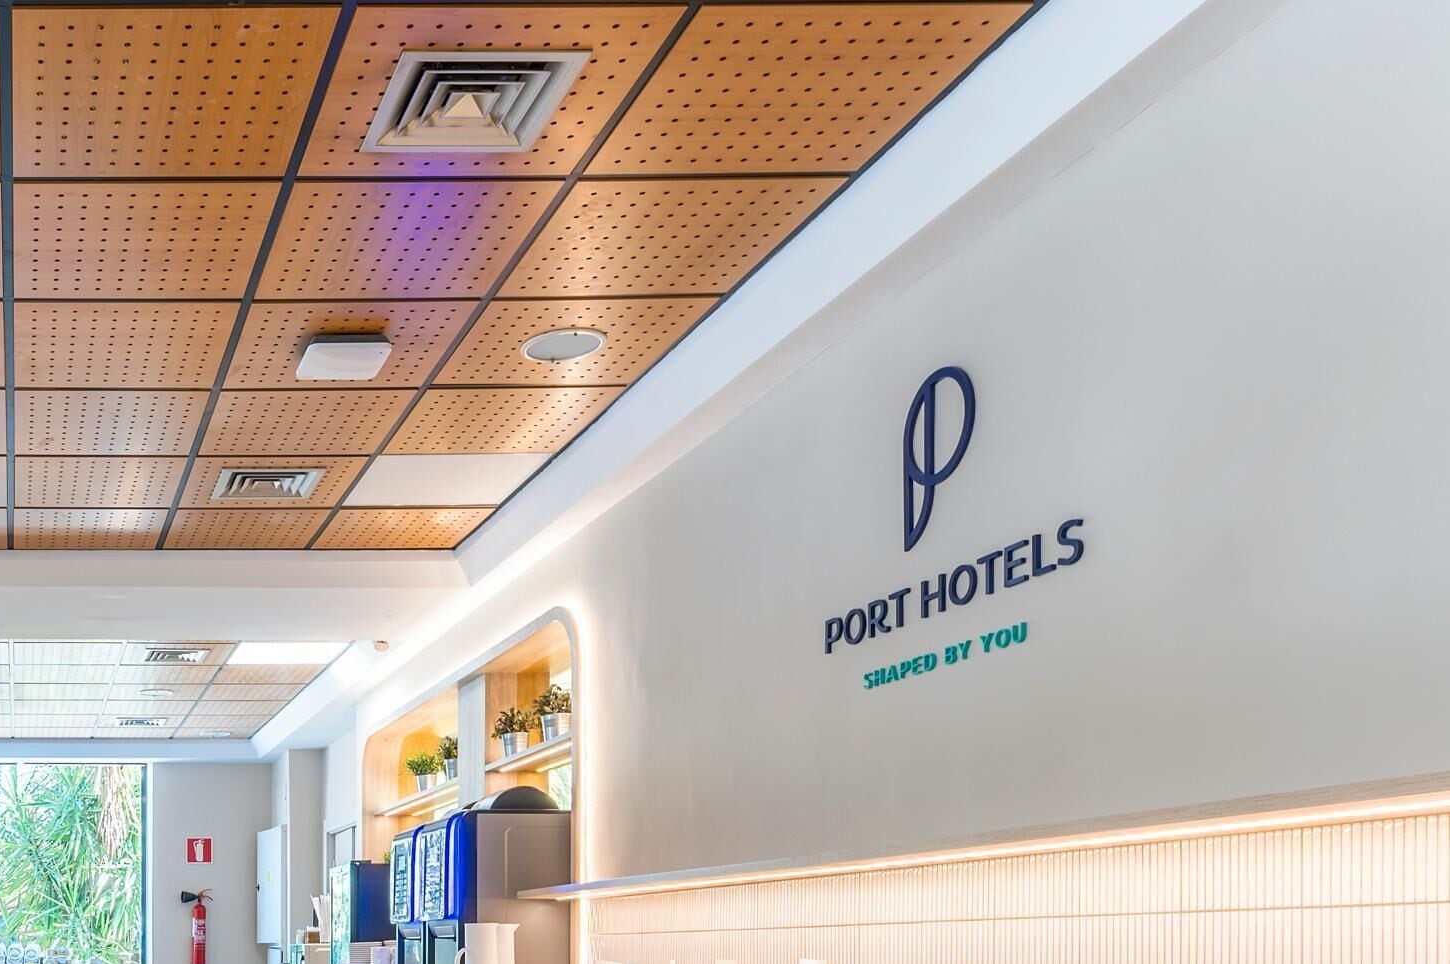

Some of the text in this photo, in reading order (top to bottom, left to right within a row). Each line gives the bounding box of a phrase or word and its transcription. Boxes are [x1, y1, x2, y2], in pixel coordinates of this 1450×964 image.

[824, 518, 1085, 655] PORT HOTELS
[863, 621, 1028, 689] SHAPED BY YOU
